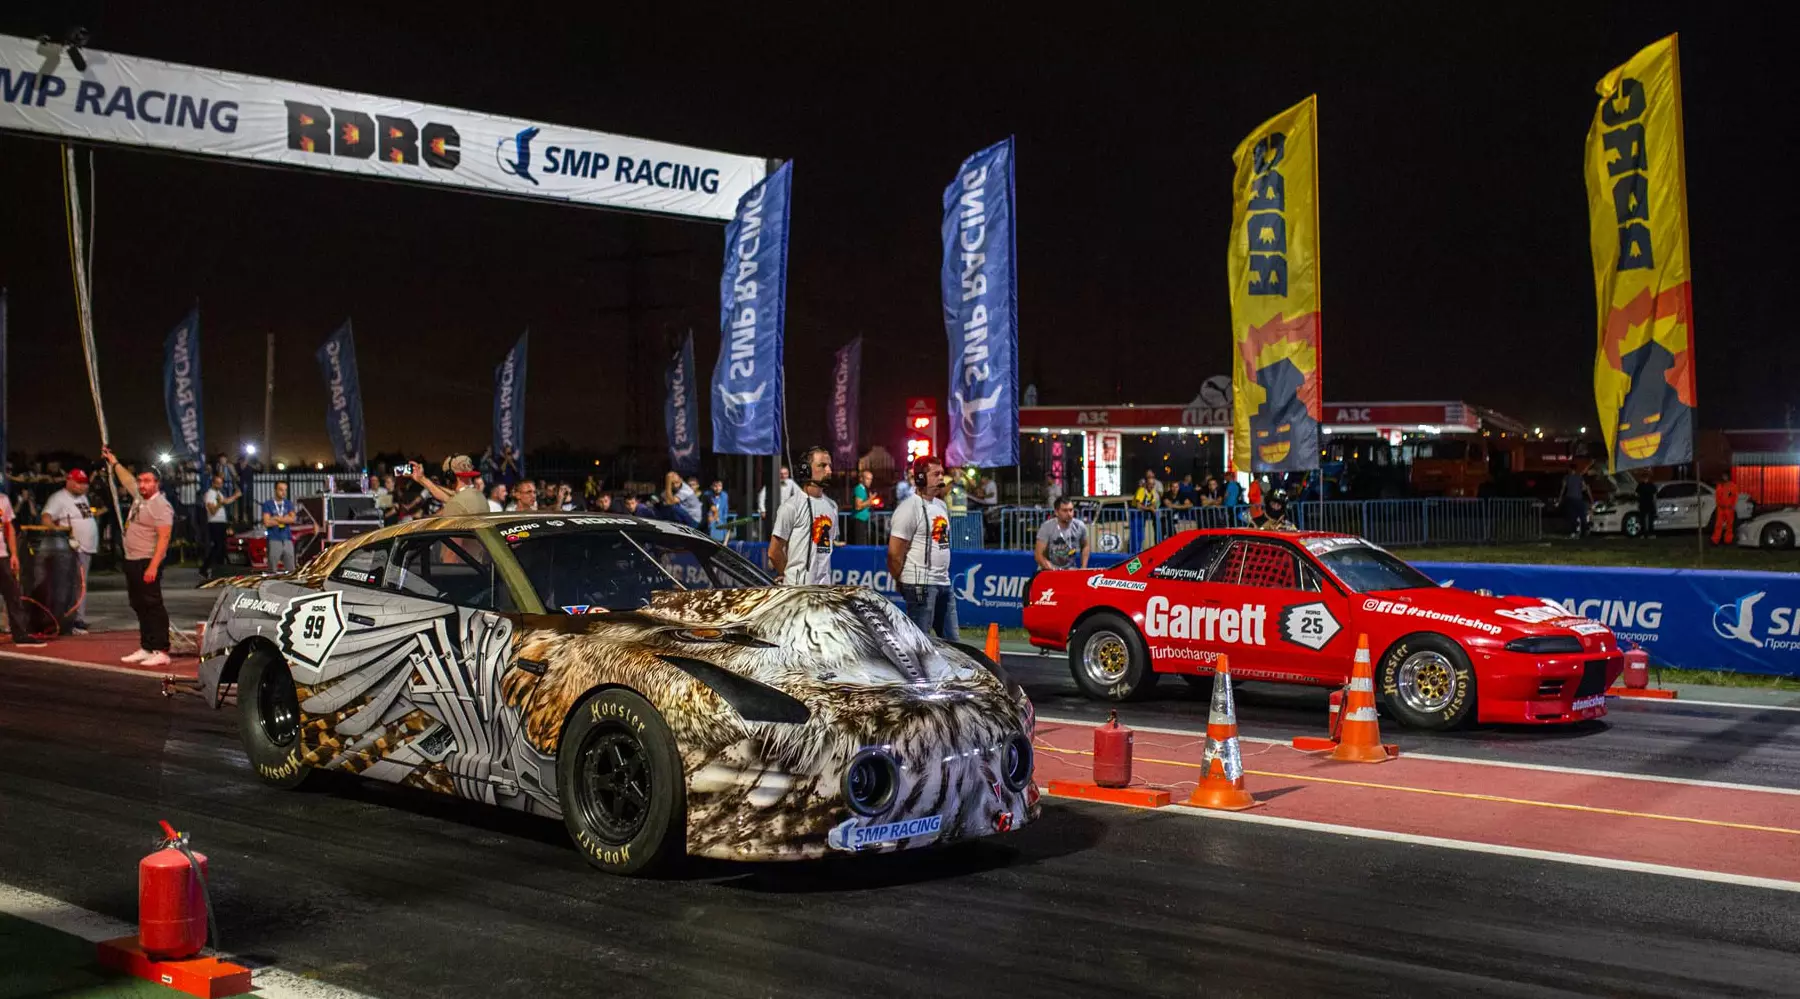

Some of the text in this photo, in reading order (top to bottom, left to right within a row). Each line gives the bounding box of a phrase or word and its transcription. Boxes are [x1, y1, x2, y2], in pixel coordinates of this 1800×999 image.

[0, 68, 239, 133] MP RACING
[285, 100, 460, 170] RDRC
[542, 146, 720, 194] SMP RACING
[1076, 412, 1109, 424] АЗС
[1336, 408, 1371, 421] АЗС
[500, 523, 540, 536] RACING
[1099, 578, 1146, 590] SMP RACING
[1160, 565, 1205, 580] Капустин Д
[237, 597, 280, 614] SMP RACING
[1560, 598, 1663, 629] ACING
[303, 615, 325, 639] 99
[1145, 595, 1266, 646] Garrett
[1300, 617, 1323, 634] 25
[1406, 606, 1502, 635] #atomicshop
[1614, 631, 1659, 642] тоспорта
[1383, 644, 1408, 697] Hoosier
[591, 700, 646, 733] Hoosier
[855, 815, 940, 843] SMP RACING
